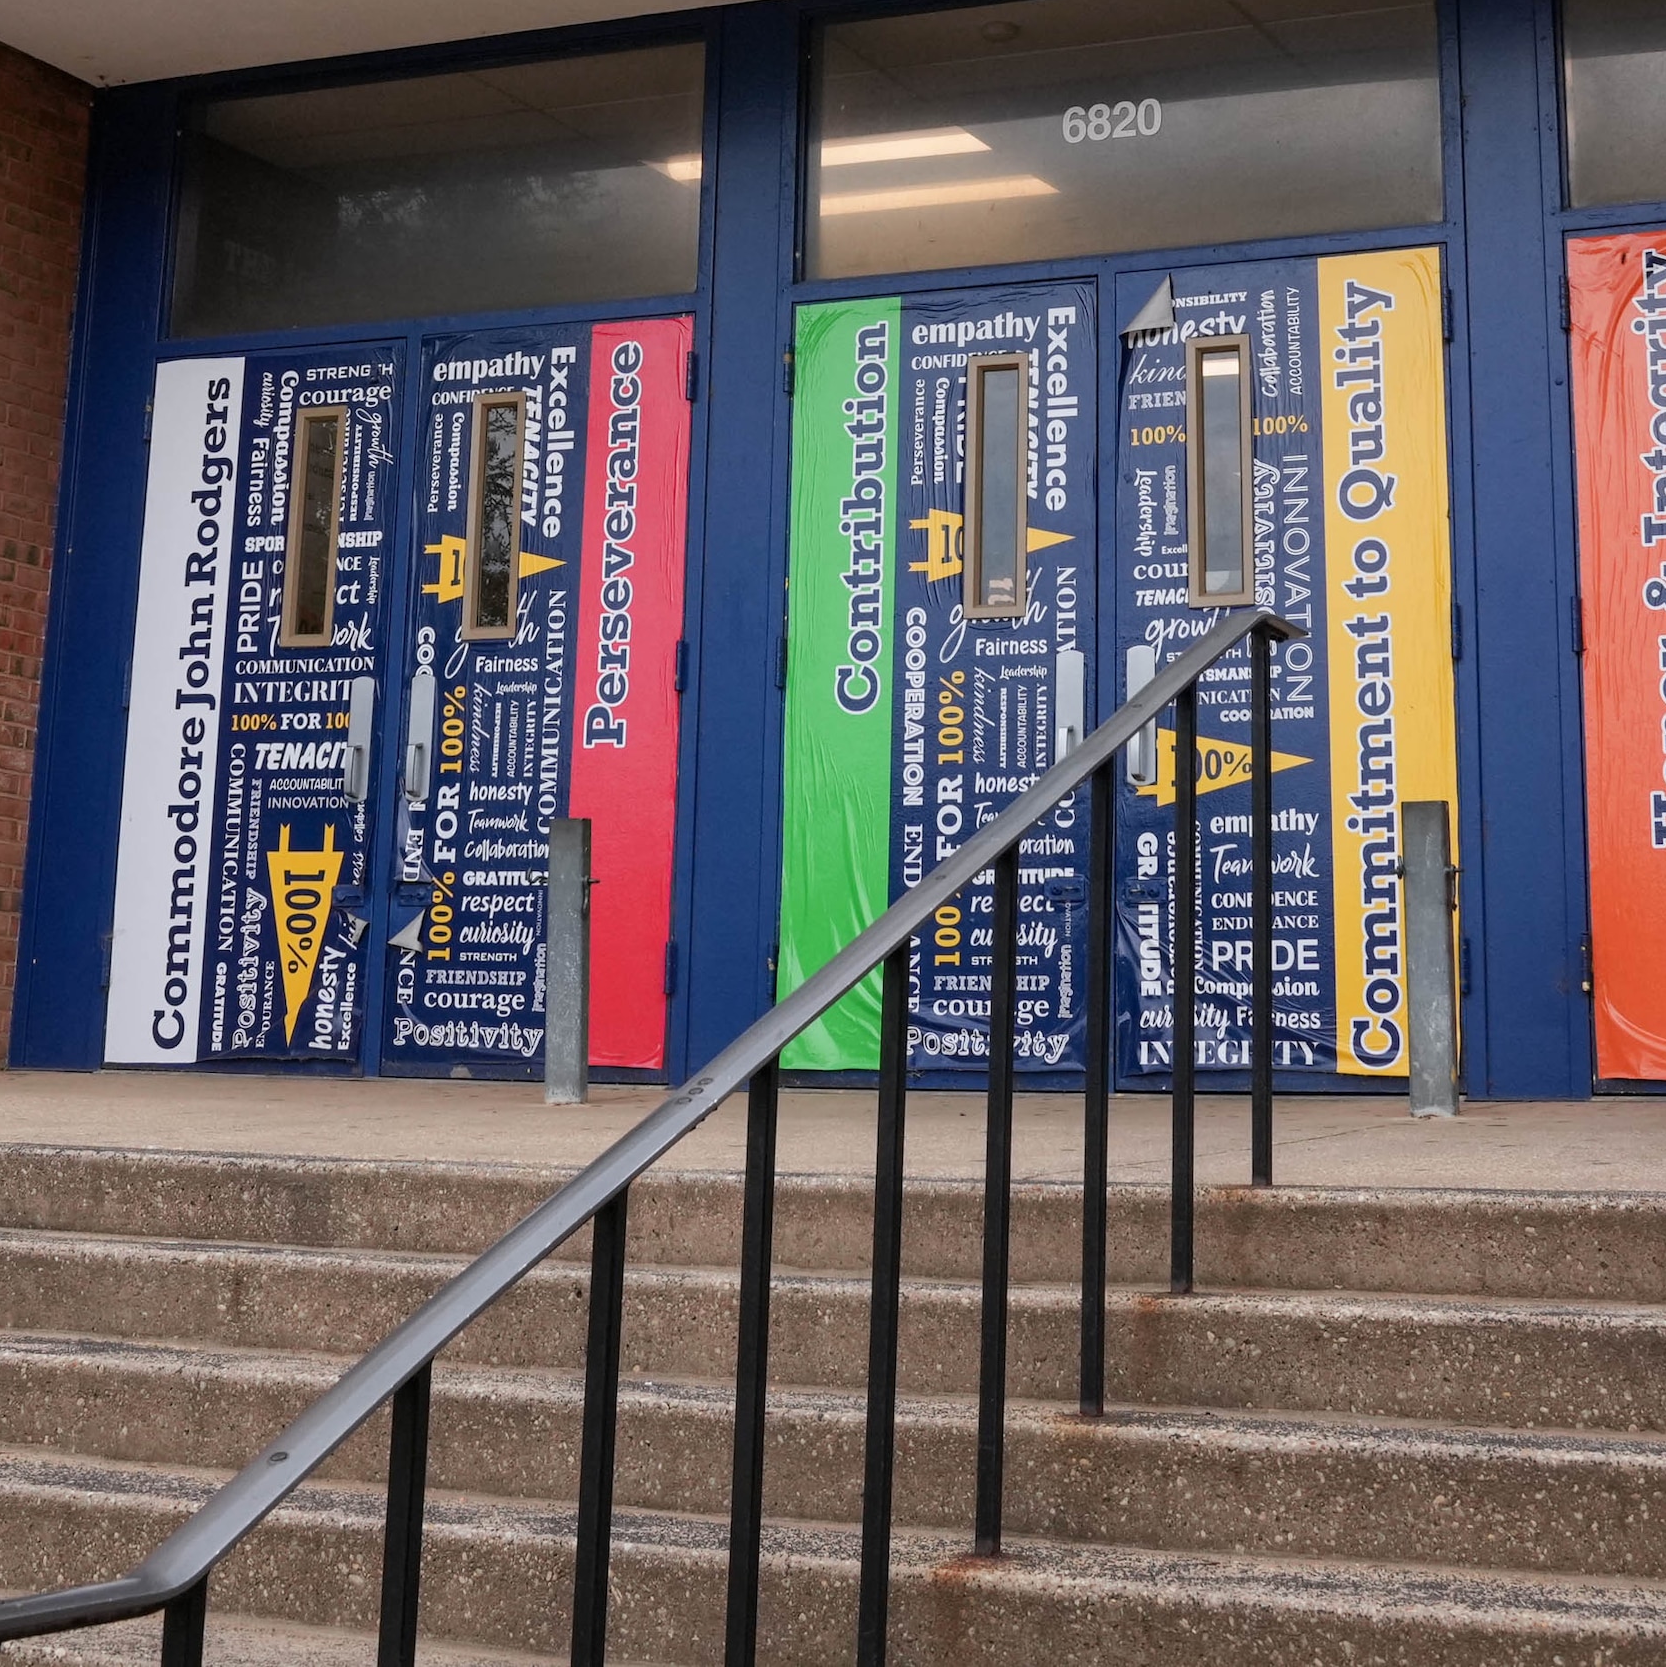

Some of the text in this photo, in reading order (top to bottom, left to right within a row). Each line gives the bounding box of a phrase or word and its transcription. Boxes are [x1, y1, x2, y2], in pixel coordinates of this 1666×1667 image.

[1063, 98, 1161, 143] 6820
[433, 351, 545, 384] empathy
[912, 312, 1040, 347] empathy
[1257, 290, 1281, 397] Collaboration
[1286, 286, 1303, 395] ACCOUNTABILITY
[299, 384, 392, 407] courage
[356, 409, 394, 469] growth
[911, 378, 925, 486] Perseverance
[933, 377, 950, 484] Compassion
[1045, 306, 1078, 511] Excellence
[1131, 415, 1308, 446] 100% 100%
[247, 371, 274, 527] curiosity Fairness
[271, 371, 299, 526] Compassion
[350, 424, 363, 522] RESPONSIBILITY
[427, 413, 443, 513] Perseverance
[448, 412, 465, 512] Compassion
[543, 346, 576, 538] Excellence
[583, 340, 643, 750] Perseverance
[834, 320, 889, 715] Contribution
[1134, 468, 1157, 557] Leadership
[237, 561, 264, 653] PRIDE
[367, 556, 380, 604] Leadership
[235, 657, 375, 675] COMMUNICATION
[475, 656, 538, 673] Fairness
[496, 681, 537, 694] Leadership
[975, 638, 1047, 656] Fairness
[1000, 665, 1047, 679] Leadership
[1333, 279, 1405, 1071] Commitment to Quality
[152, 377, 233, 1049] Commodore John Rodgers
[232, 712, 322, 731] 100% FOR
[469, 683, 492, 773] kindness
[492, 702, 501, 777] RESPONSIBILITY
[507, 700, 519, 778] ACCOUNTABILITY
[523, 699, 536, 777] INTEGRITY
[903, 607, 927, 806] COOPERATION
[973, 667, 995, 763] kindness
[1017, 685, 1027, 768] ACCOUNTABILITY
[1036, 684, 1047, 768] INTEGRITY
[268, 796, 350, 809] INNOVATION
[469, 782, 532, 802] honesty
[936, 671, 965, 862] FOR 100%
[247, 779, 262, 879] FRIENDSHIP
[427, 686, 466, 961] 100% FOR 100%
[467, 810, 529, 834] Teamwork
[211, 744, 245, 1052] COMMUNICATION GRATITUDE
[284, 869, 326, 974] 100%
[459, 921, 535, 955] curiosity
[461, 892, 534, 922] respect
[231, 887, 267, 1050] Positivity
[309, 947, 345, 1050] honesty
[426, 970, 526, 986] FRIENDSHIP
[459, 952, 516, 961] STRENGTH
[255, 961, 274, 1048] ENDURANCE
[337, 963, 356, 1050] Excellence
[393, 1018, 543, 1057] Positivity
[424, 990, 525, 1017] courage
